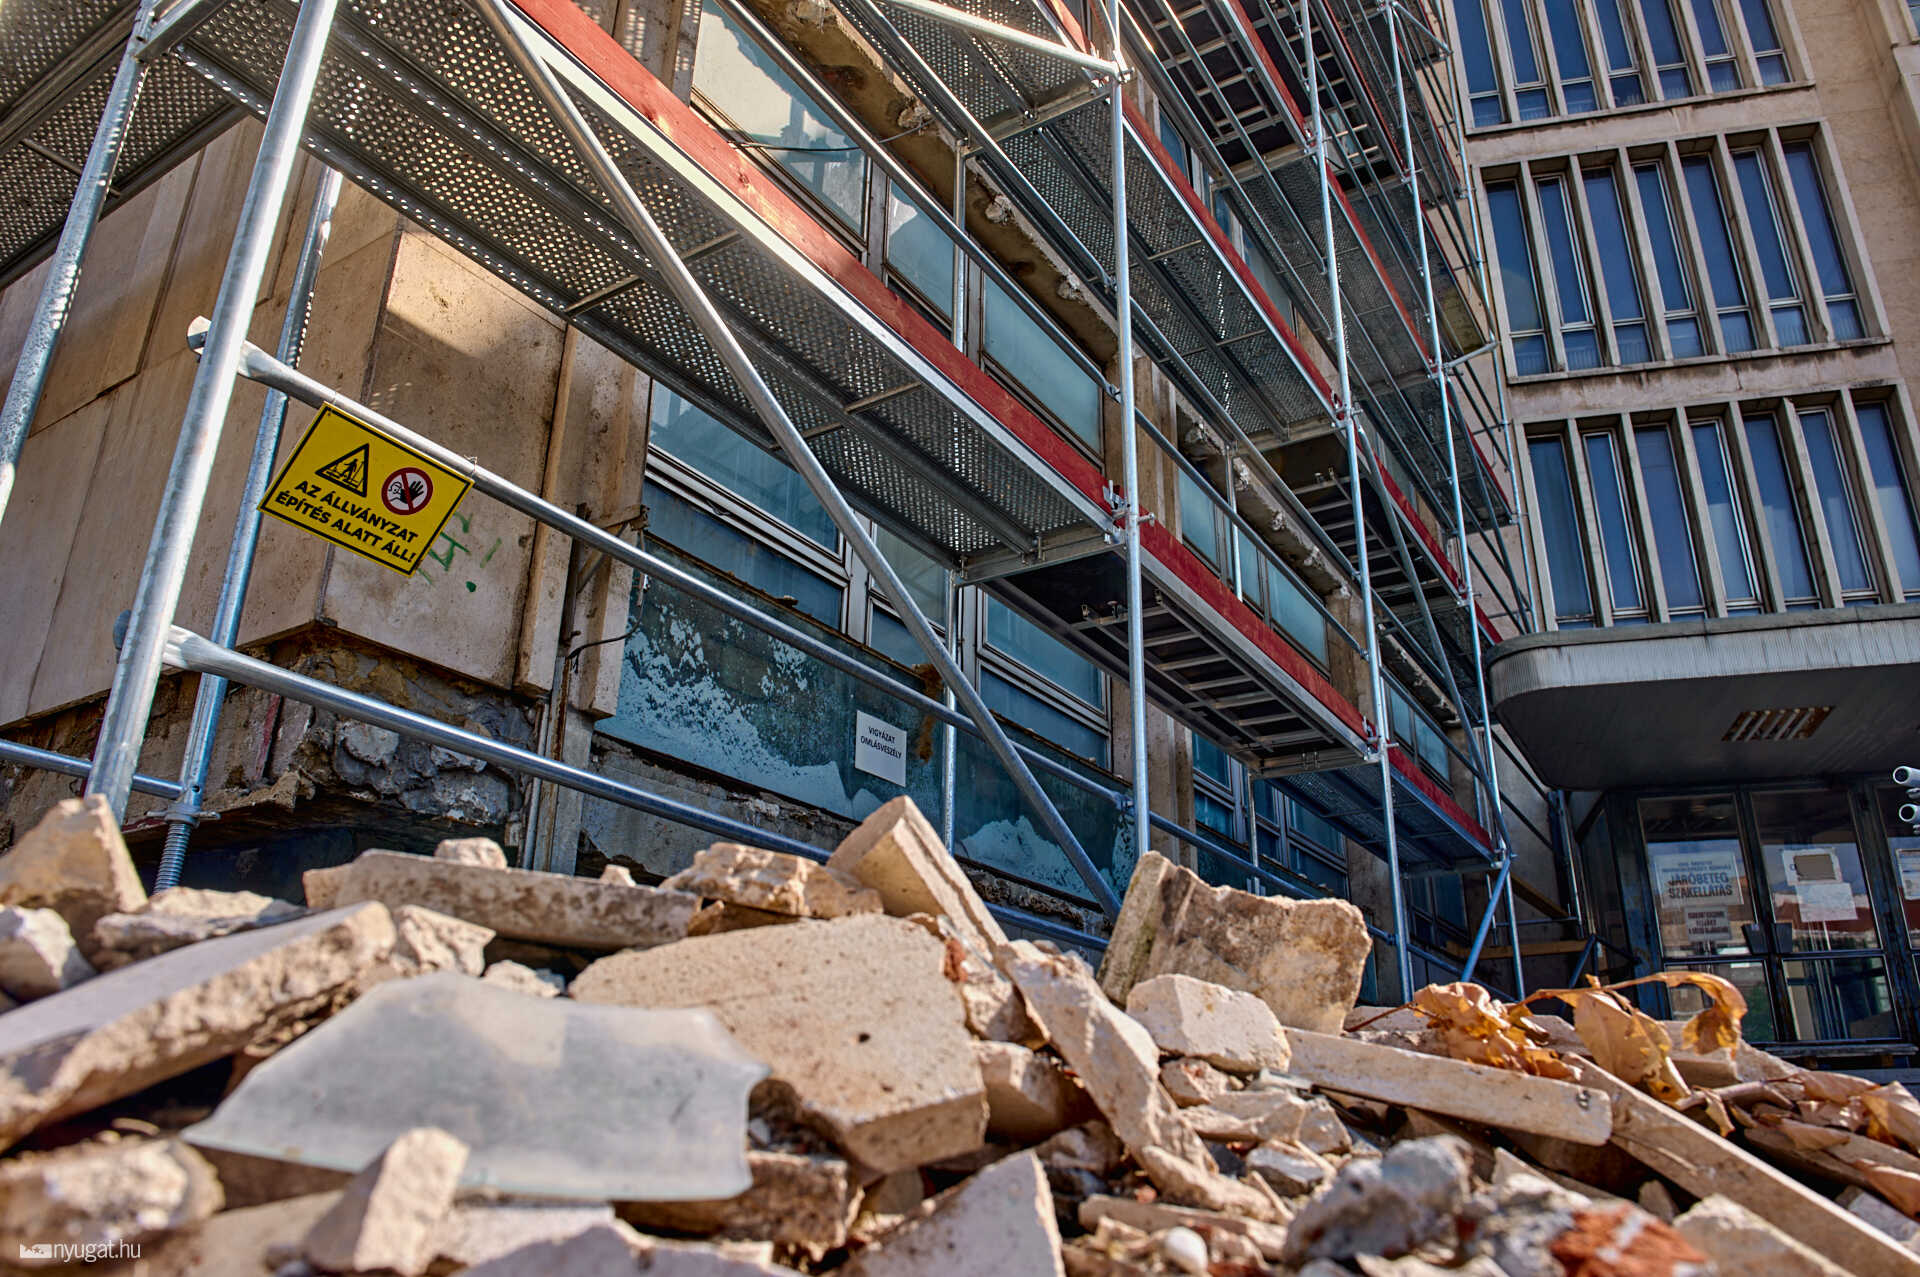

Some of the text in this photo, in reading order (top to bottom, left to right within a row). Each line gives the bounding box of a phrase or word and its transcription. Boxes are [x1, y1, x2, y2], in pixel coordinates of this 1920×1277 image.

[275, 490, 417, 563] ÉPÍTÉS ALATT ÁLL!
[295, 480, 419, 544] AZ ÁLLVÁNYZAT
[868, 727, 895, 744] VIGYÁZAT
